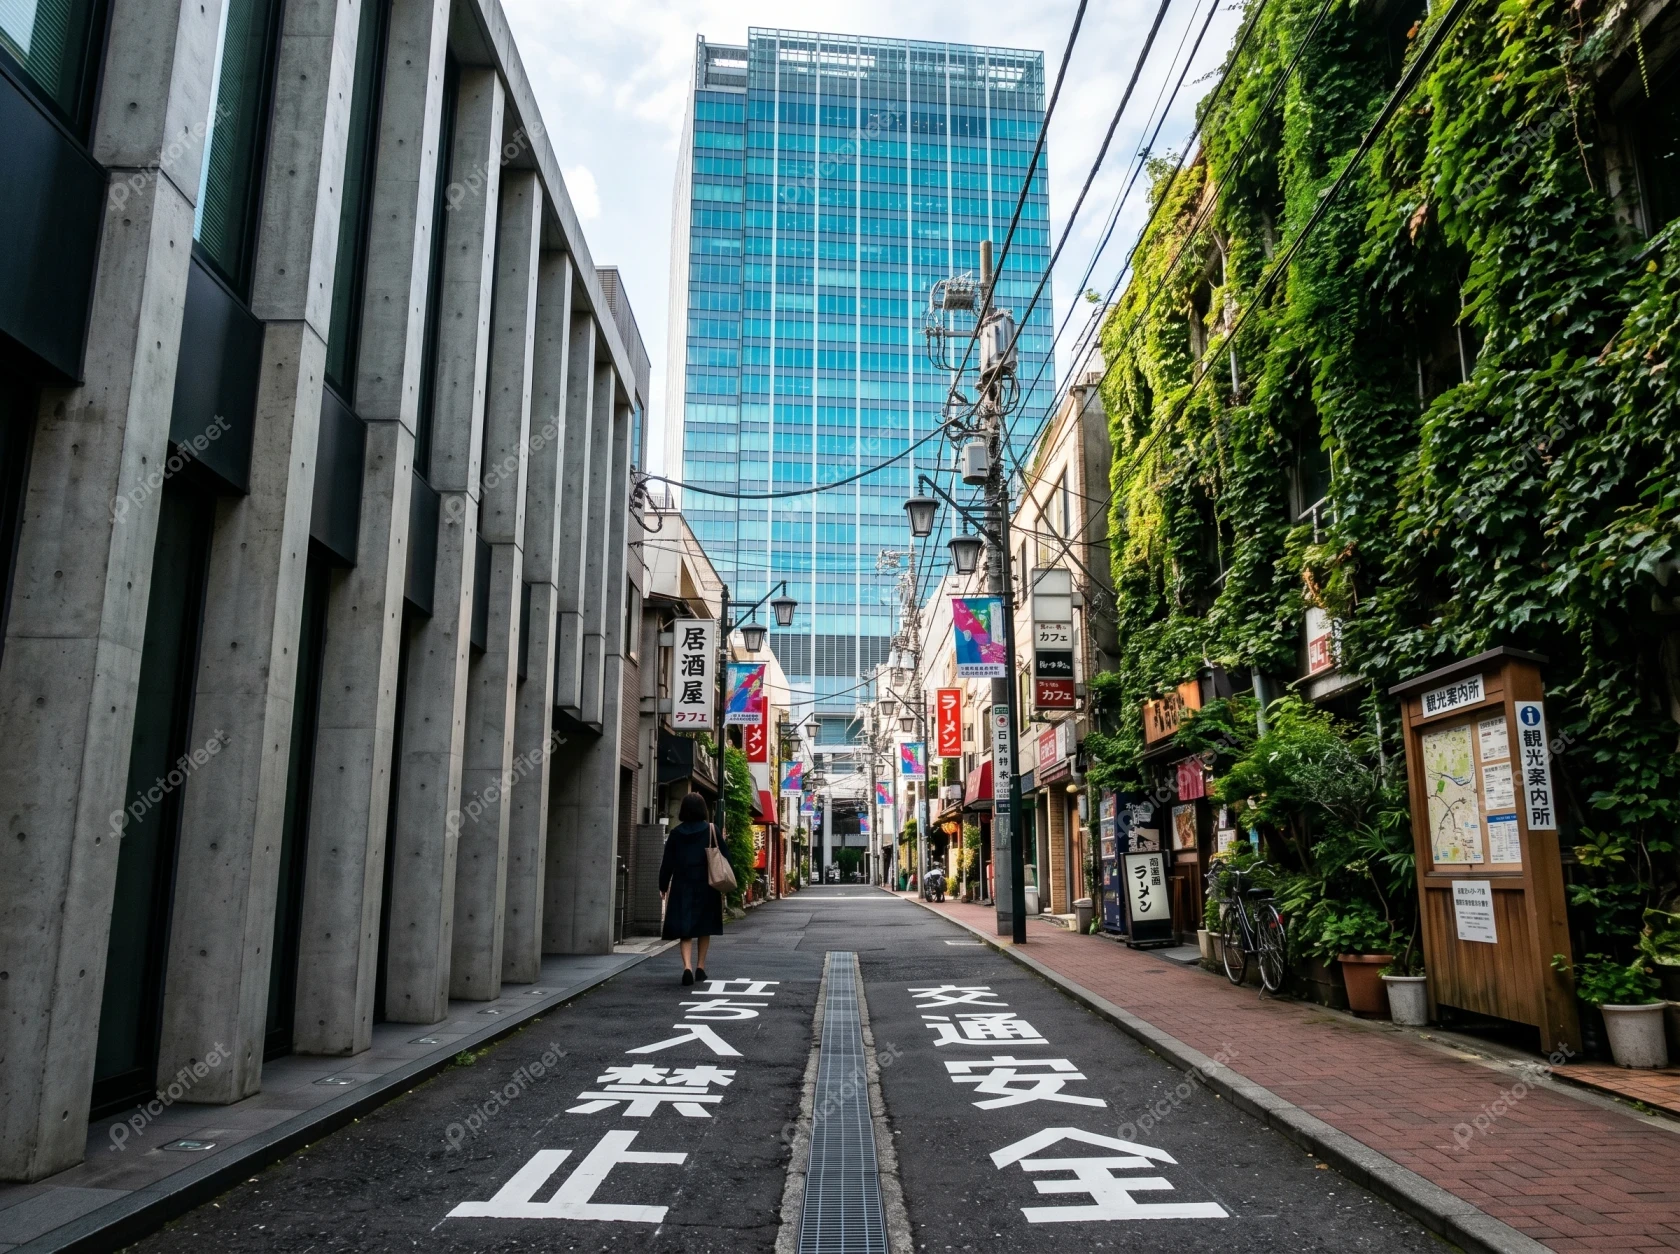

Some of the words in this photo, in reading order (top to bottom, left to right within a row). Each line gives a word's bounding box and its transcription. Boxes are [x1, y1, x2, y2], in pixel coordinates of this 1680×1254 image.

[1040, 632, 1068, 642] カフェ
[679, 627, 707, 704] 居酒屋
[1042, 690, 1072, 701] カフェ
[1426, 678, 1480, 712] 観光案内所
[748, 724, 763, 757] メン
[941, 694, 957, 748] ラーメン
[1523, 730, 1551, 826] 観光案内所
[1134, 865, 1152, 912] ラーメン
[445, 978, 780, 1223] 立ち入禁止
[907, 985, 1230, 1223] 交通安全
